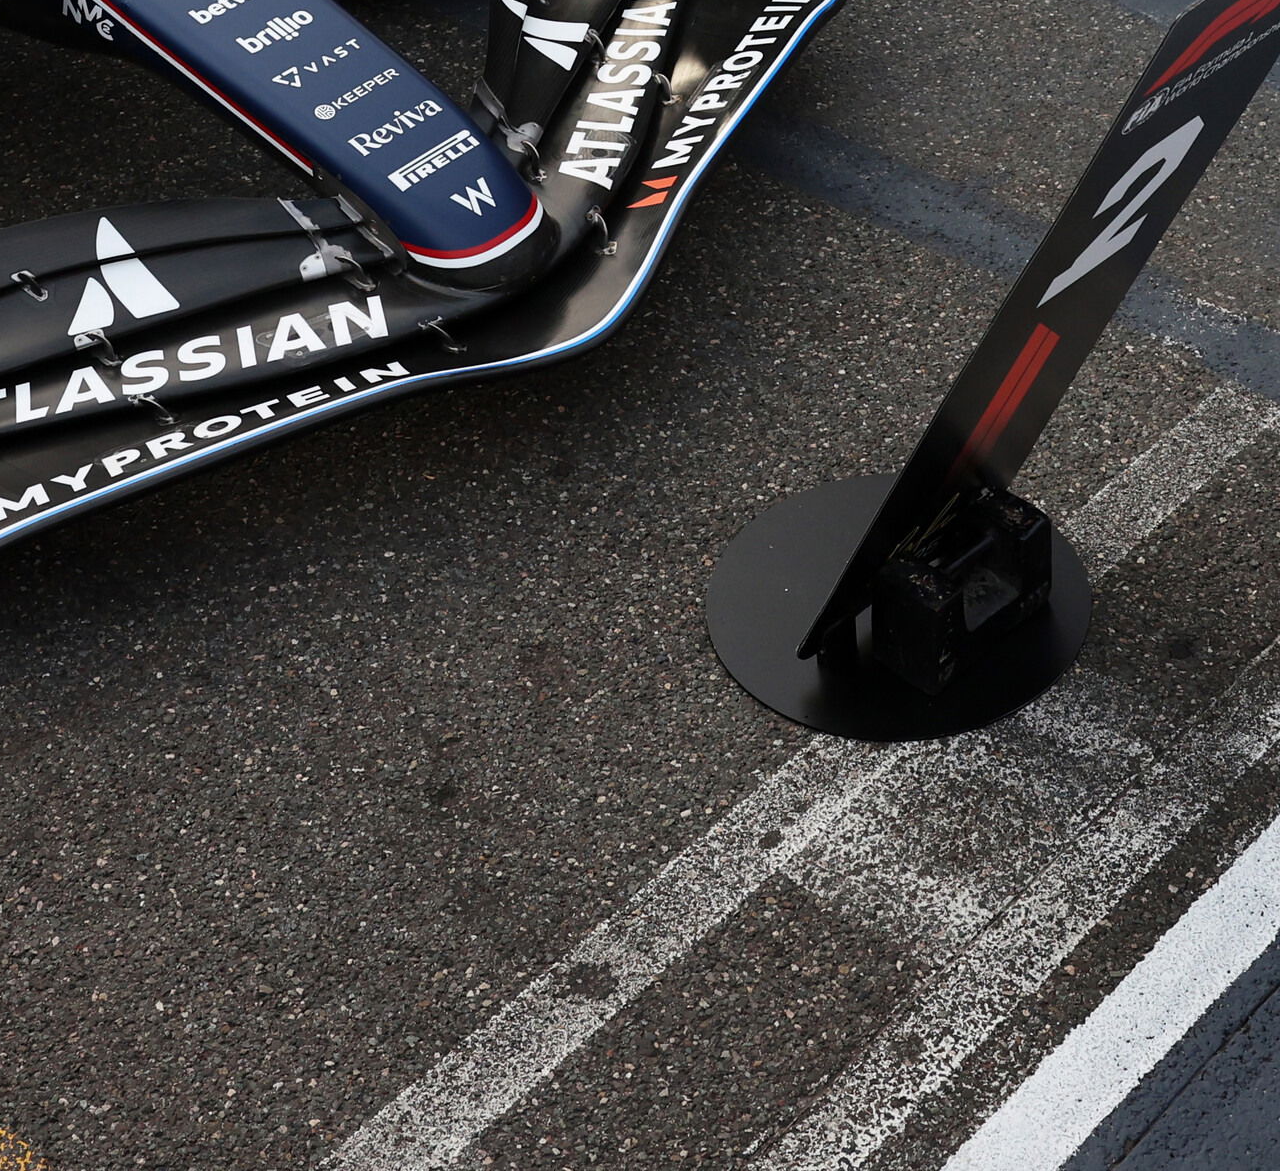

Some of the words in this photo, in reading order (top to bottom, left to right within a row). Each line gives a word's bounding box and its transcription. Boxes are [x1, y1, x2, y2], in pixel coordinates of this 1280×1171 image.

[235, 10, 314, 54] brillio
[304, 38, 362, 74] VAST
[333, 67, 401, 111] KEEPER
[347, 99, 443, 157] Reviva
[387, 129, 481, 193] PIRELLI
[1036, 115, 1204, 309] 2
